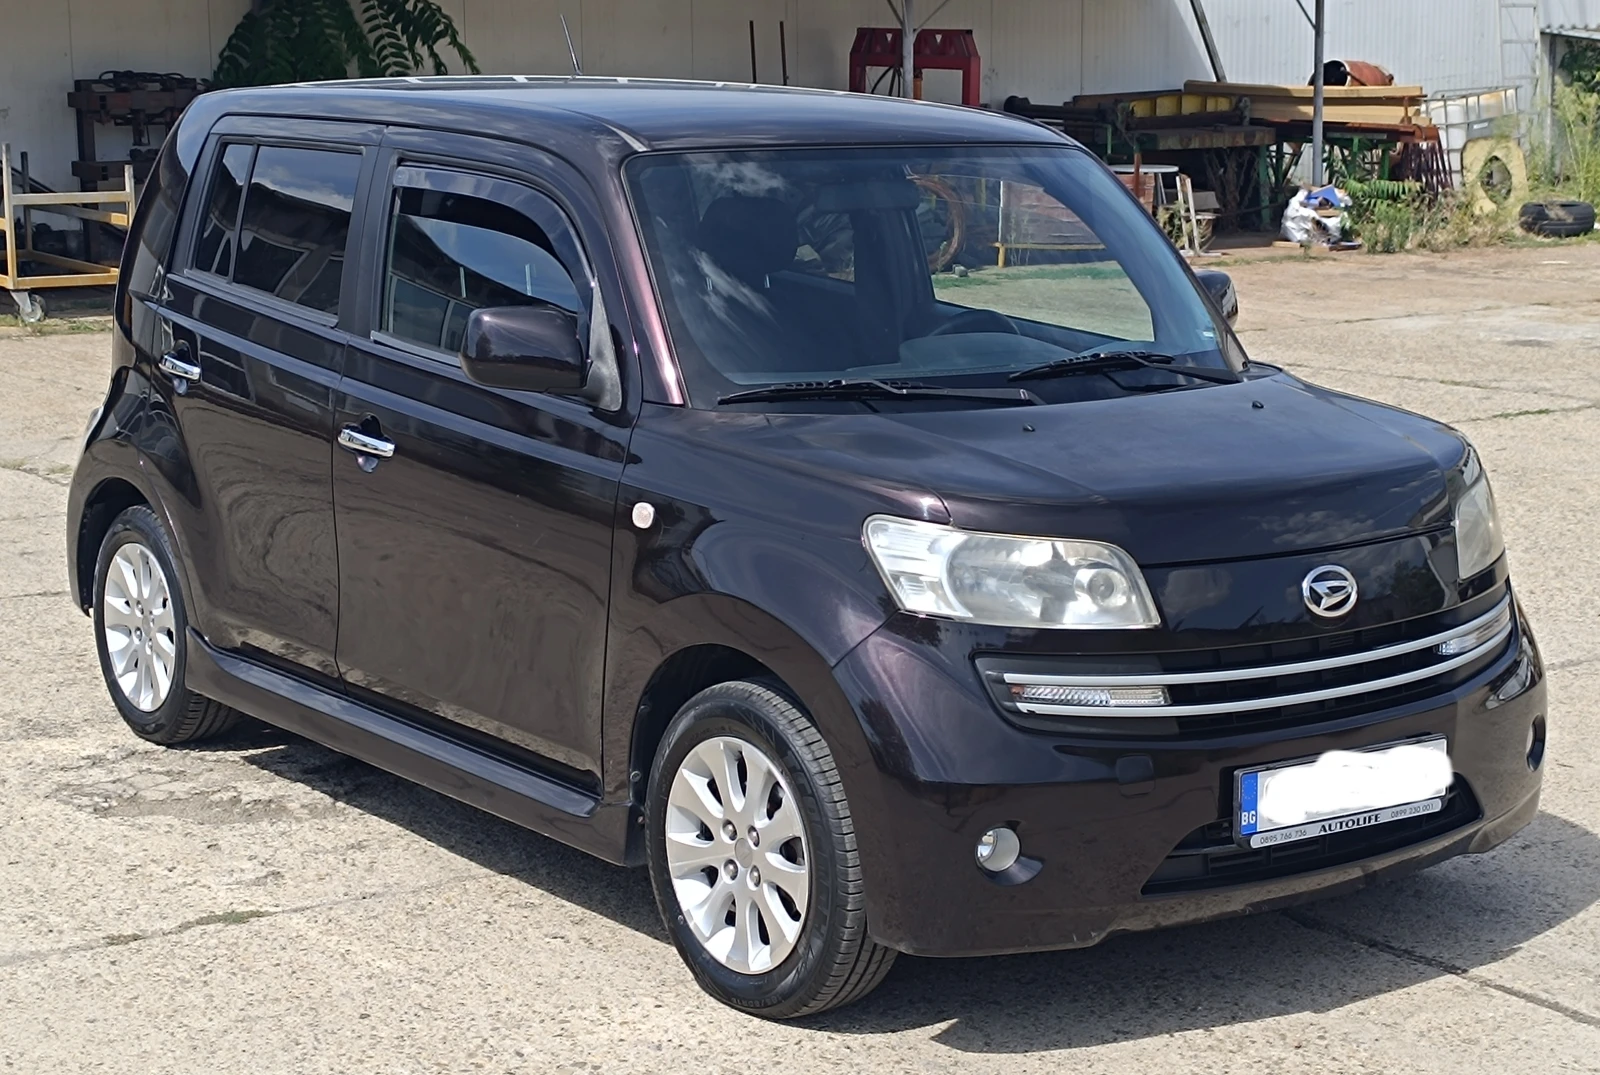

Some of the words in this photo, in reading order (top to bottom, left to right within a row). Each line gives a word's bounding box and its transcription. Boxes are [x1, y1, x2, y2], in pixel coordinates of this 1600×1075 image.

[1241, 811, 1256, 826] BG
[1259, 834, 1278, 845] 0895
[1318, 814, 1381, 834] AUTOLIFE
[1391, 809, 1408, 819] 0899
